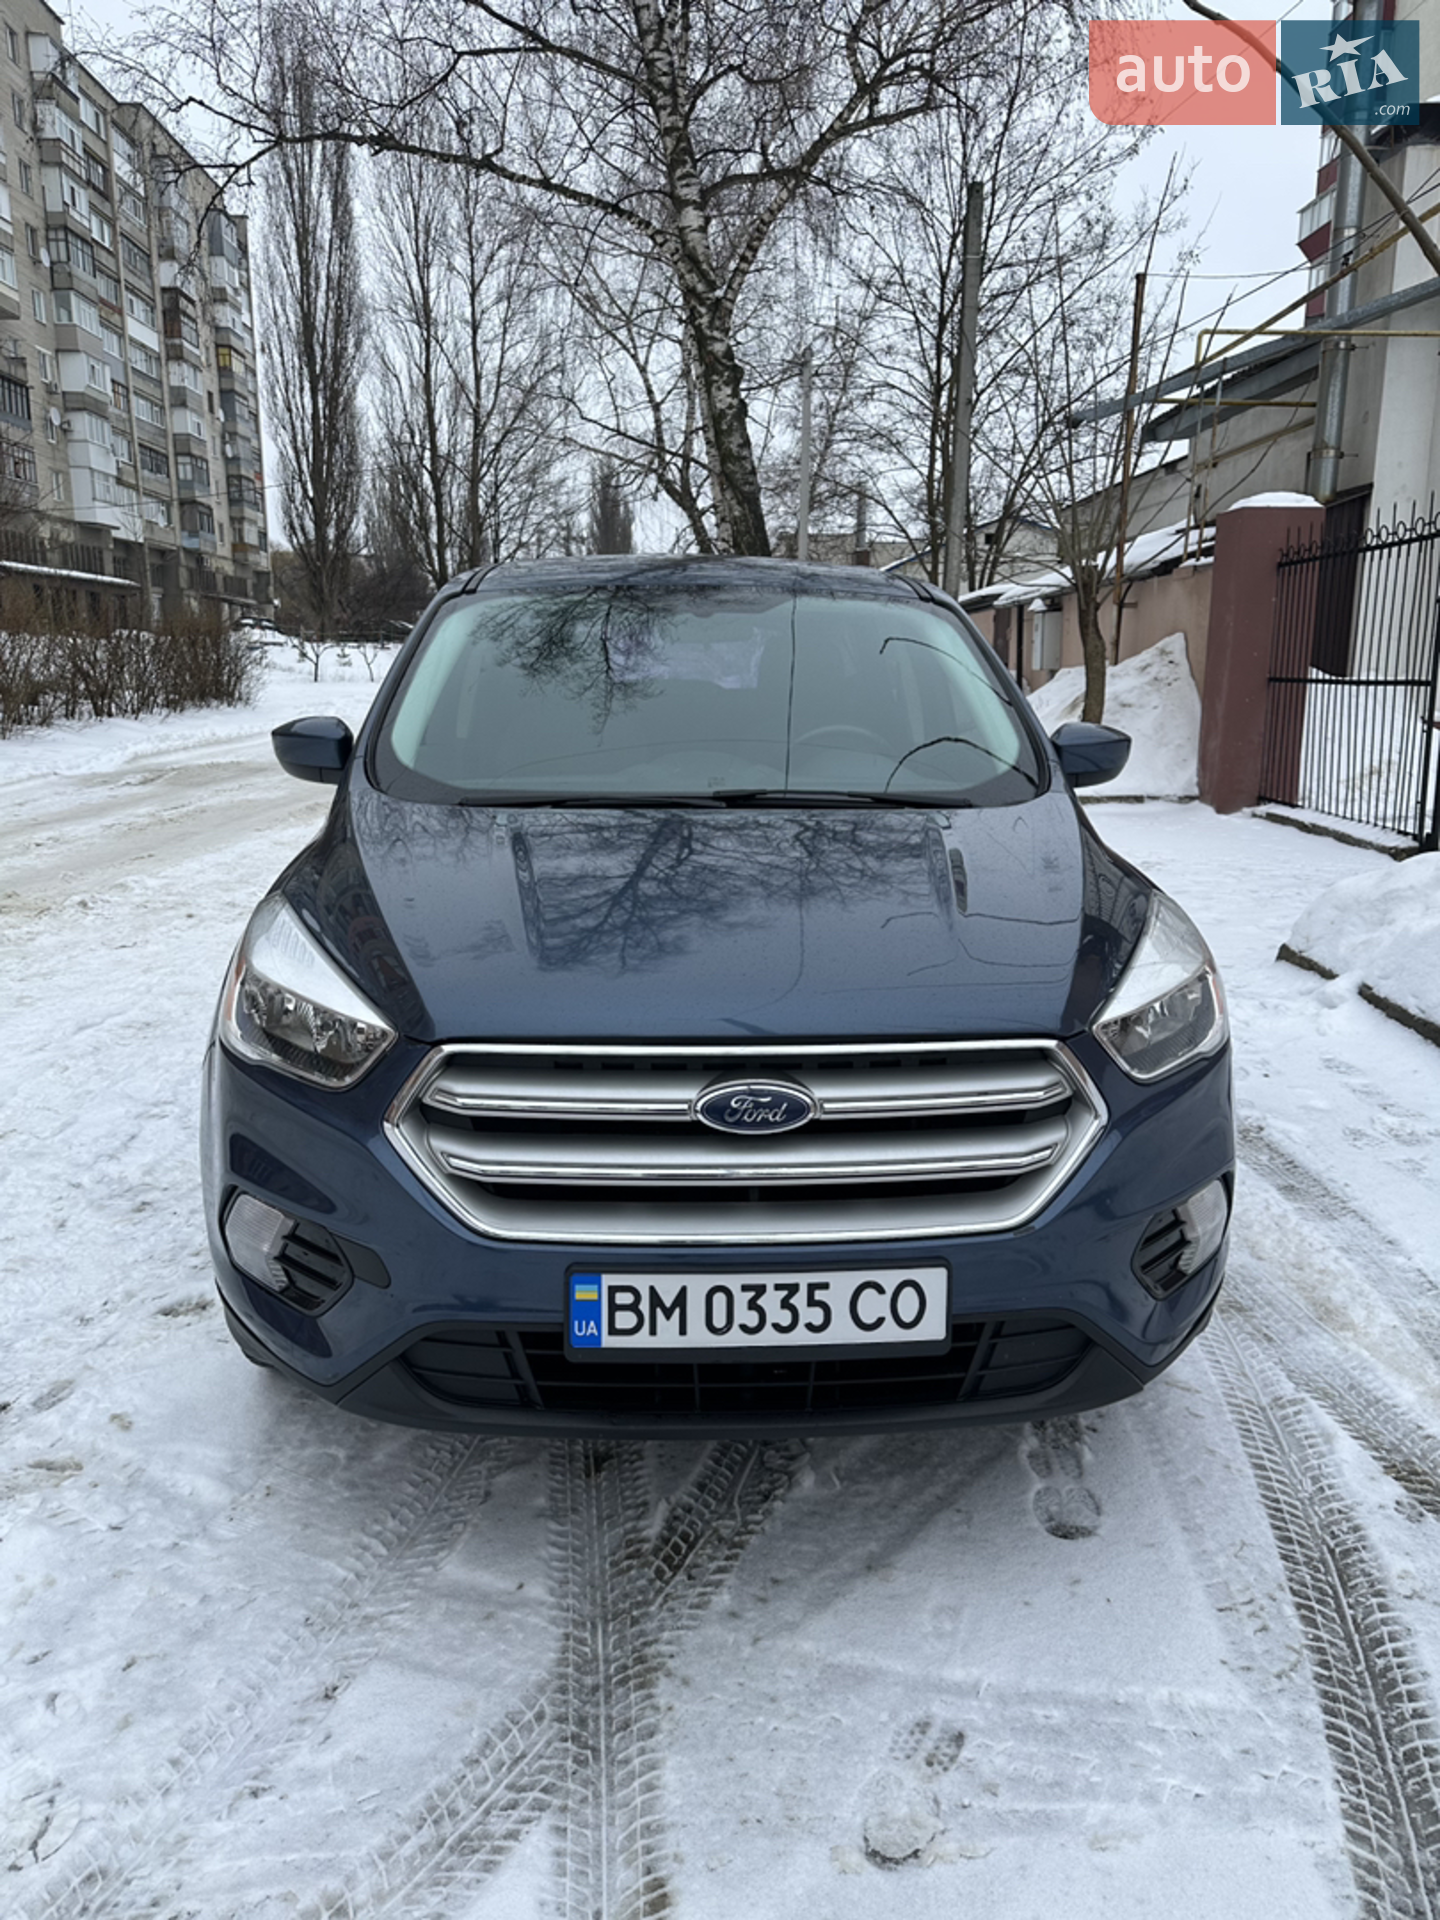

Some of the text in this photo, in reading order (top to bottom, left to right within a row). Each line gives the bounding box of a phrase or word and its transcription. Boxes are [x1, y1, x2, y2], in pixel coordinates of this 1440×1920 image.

[724, 1095, 788, 1122] Ford
[606, 1279, 928, 1337] BM 0335 CO
[574, 1320, 599, 1337] UA
